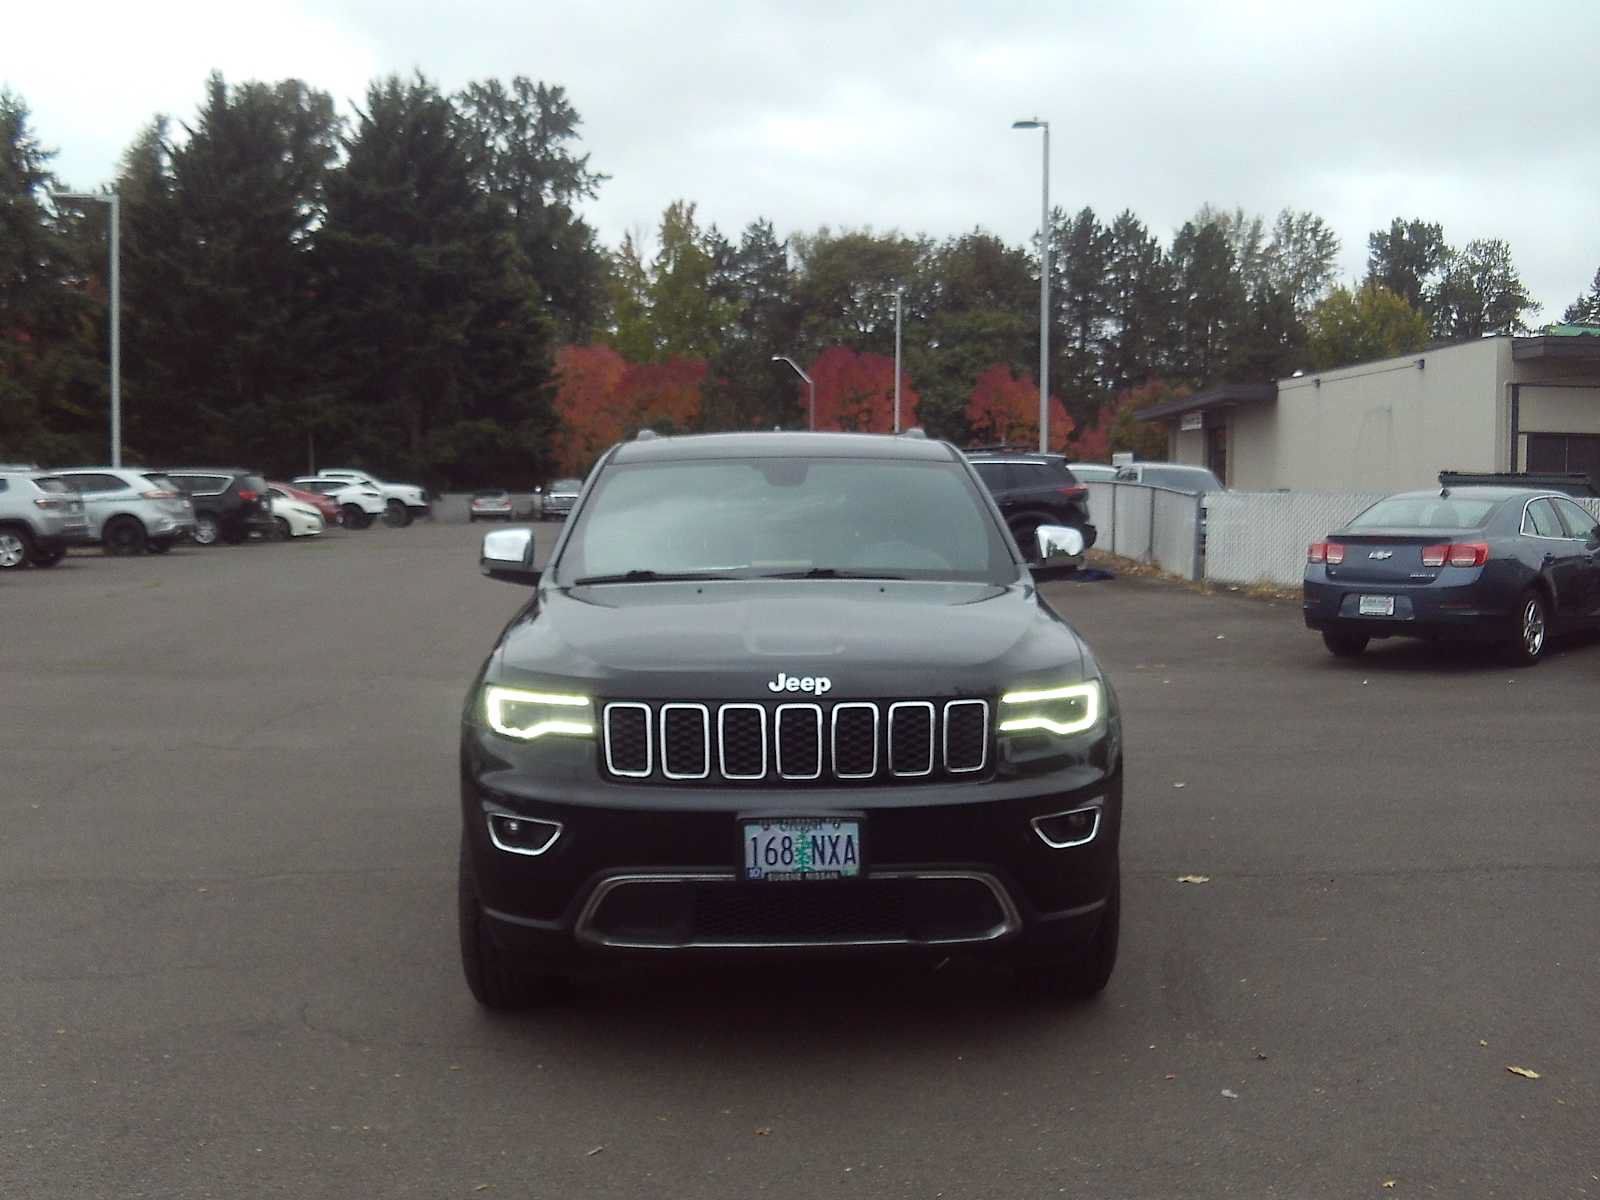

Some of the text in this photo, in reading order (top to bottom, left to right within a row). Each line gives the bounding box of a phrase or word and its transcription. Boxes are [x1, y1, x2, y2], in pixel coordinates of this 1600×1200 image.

[768, 672, 832, 695] Jeep
[751, 835, 857, 866] 168 NXA
